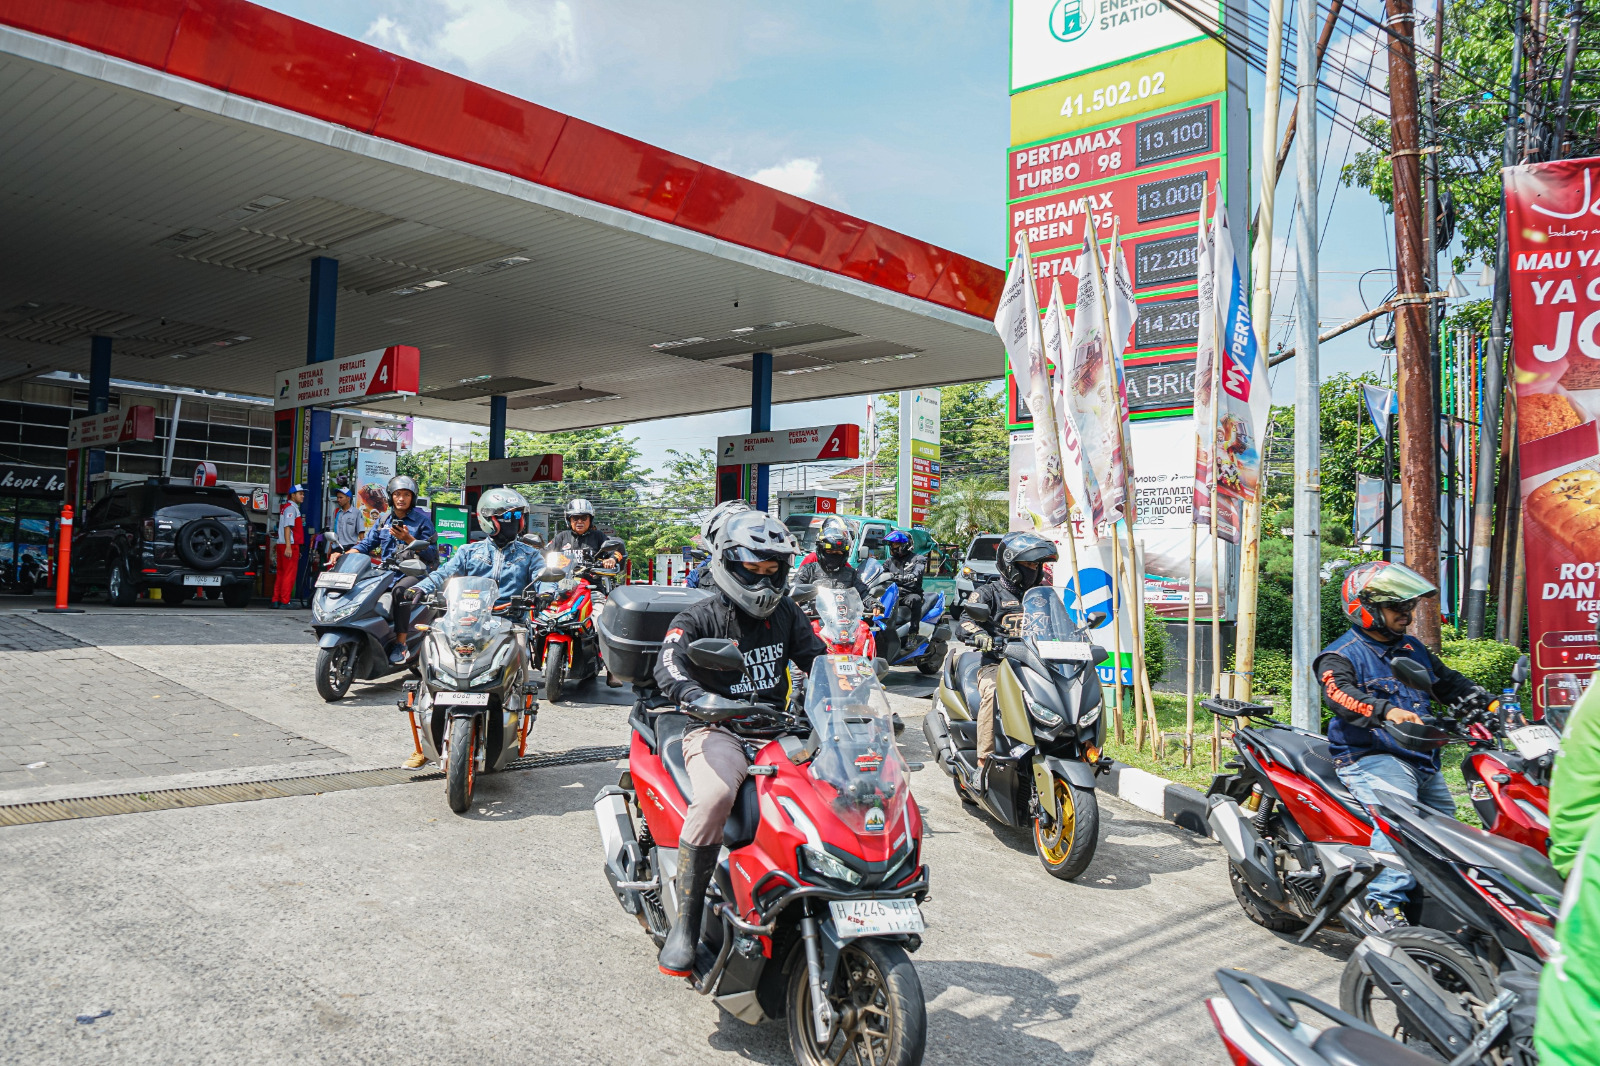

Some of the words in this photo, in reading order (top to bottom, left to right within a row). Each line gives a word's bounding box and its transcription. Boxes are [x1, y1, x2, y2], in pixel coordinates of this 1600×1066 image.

[1060, 71, 1166, 119] 41.502.02
[1143, 121, 1203, 151] 13.100
[1016, 127, 1122, 170] PERTAMAX
[1017, 163, 1080, 193] TURBO
[1097, 151, 1122, 173] 98
[1139, 181, 1202, 212] 13.000
[1014, 191, 1114, 228] PERTAMAX
[1014, 219, 1074, 246] GREEN
[1516, 252, 1571, 271] MAU
[1531, 279, 1577, 305] YA
[298, 368, 324, 380] PERTAMAX
[339, 359, 366, 372] PERTALITE
[379, 365, 389, 385] 4
[338, 372, 367, 385] PERTAMAX
[125, 420, 133, 434] 12
[788, 428, 819, 438] PERTAMAX
[743, 437, 775, 445] PERTAMINA
[743, 444, 755, 452] DEX
[788, 436, 808, 445] TURBO
[830, 437, 840, 452] 2
[540, 464, 549, 476] 10
[0, 470, 41, 490] kopi
[1136, 497, 1172, 506] GRAND
[1136, 516, 1165, 525] 2025
[1541, 581, 1595, 600] DAN
[740, 661, 776, 683] ADV
[836, 903, 847, 919] H
[854, 902, 887, 917] 4246
[891, 900, 919, 916] BTE
[847, 915, 866, 926] RIDE
